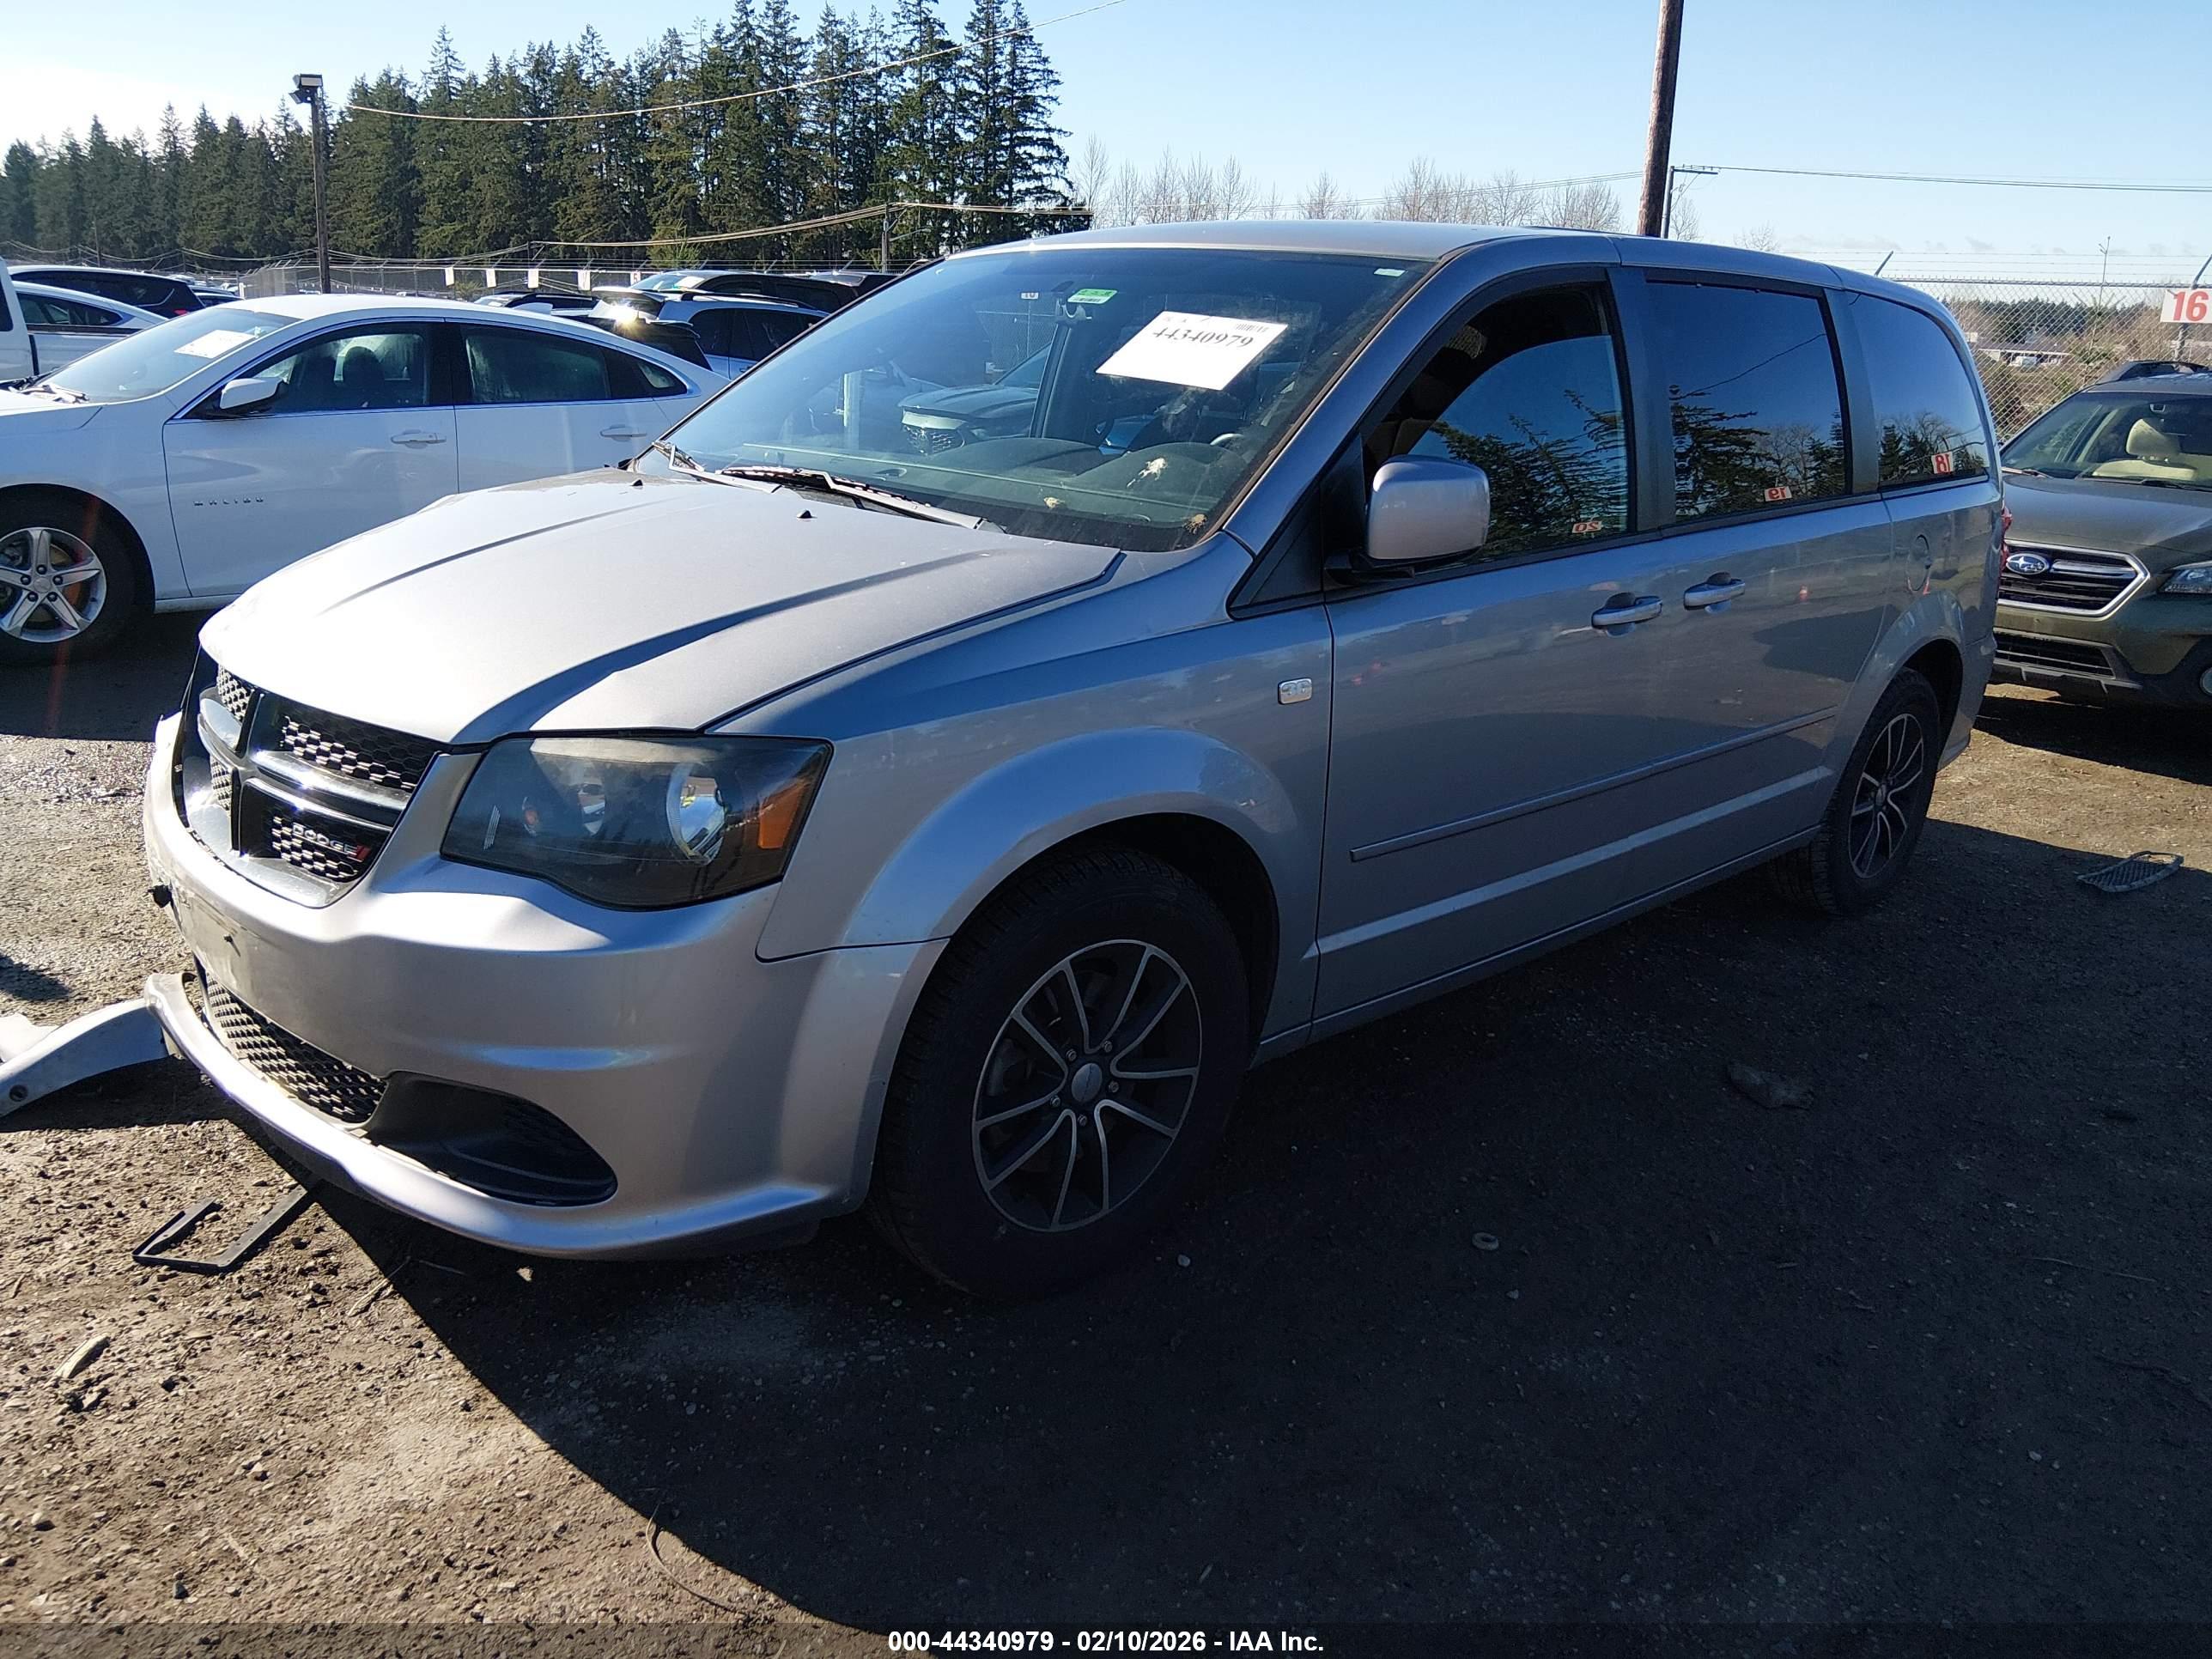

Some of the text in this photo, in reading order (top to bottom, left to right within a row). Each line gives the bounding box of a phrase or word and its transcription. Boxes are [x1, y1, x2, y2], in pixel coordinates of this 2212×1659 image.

[2172, 291, 2209, 322] 16
[1152, 327, 1254, 348] 44340979
[292, 823, 358, 856] DODGE
